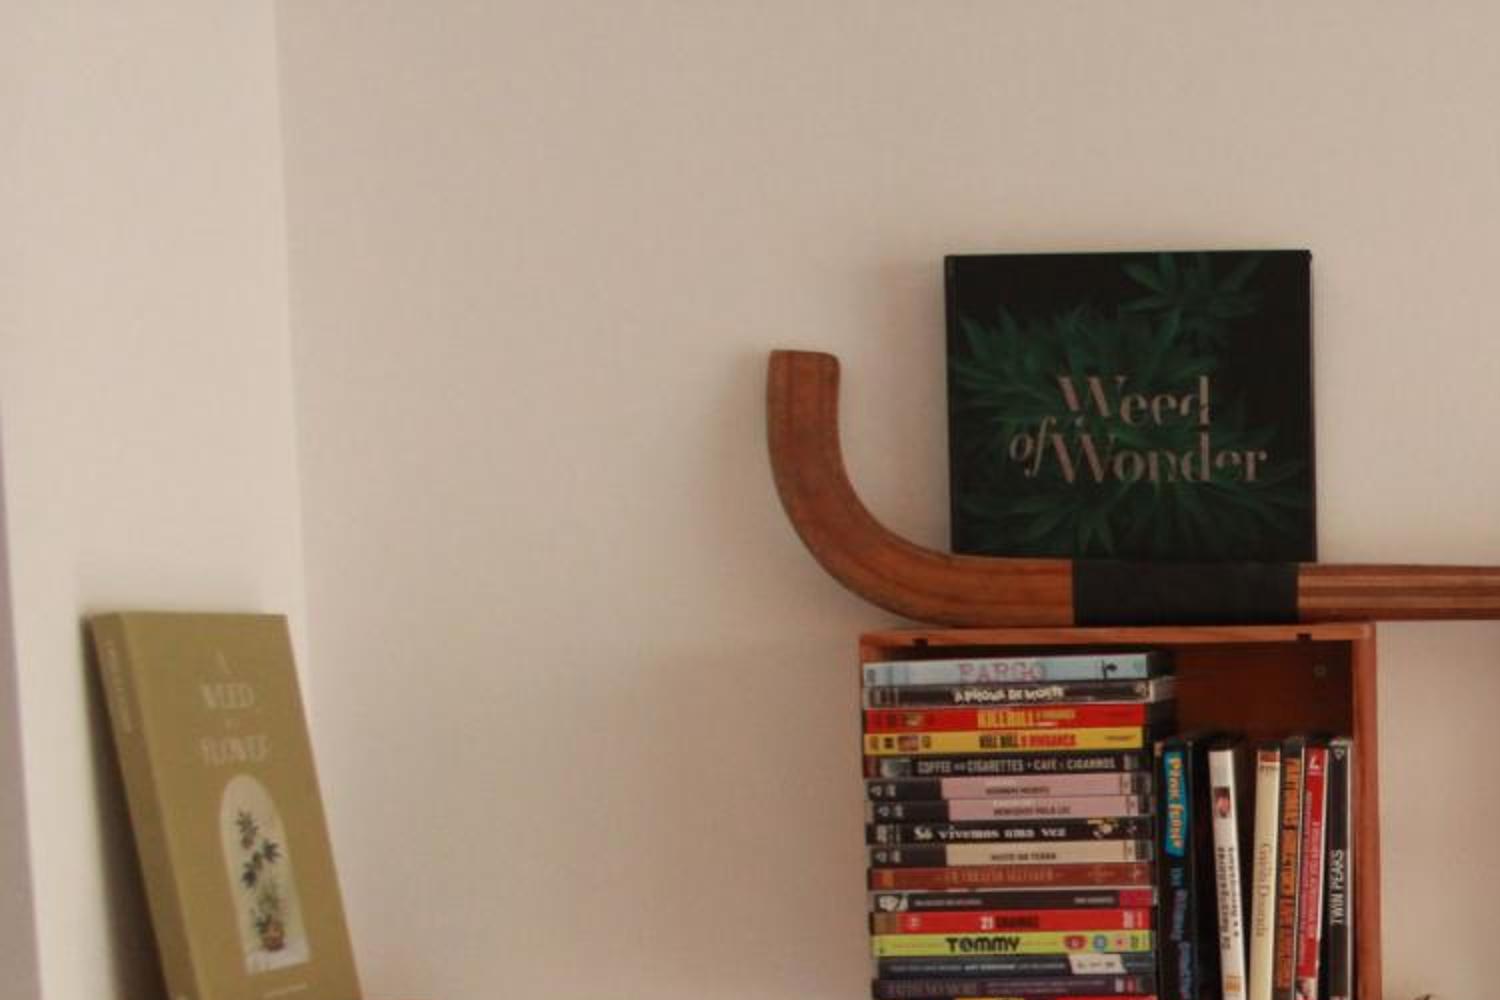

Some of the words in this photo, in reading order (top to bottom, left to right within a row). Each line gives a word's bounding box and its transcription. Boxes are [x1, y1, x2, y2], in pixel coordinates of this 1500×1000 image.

[1056, 374, 1212, 426] Weed
[1008, 416, 1056, 478] of
[1051, 428, 1268, 484] Wonder
[1329, 849, 1344, 890] PEAKS
[1329, 893, 1344, 927] TWIN
[946, 937, 1020, 953] TOMMY
